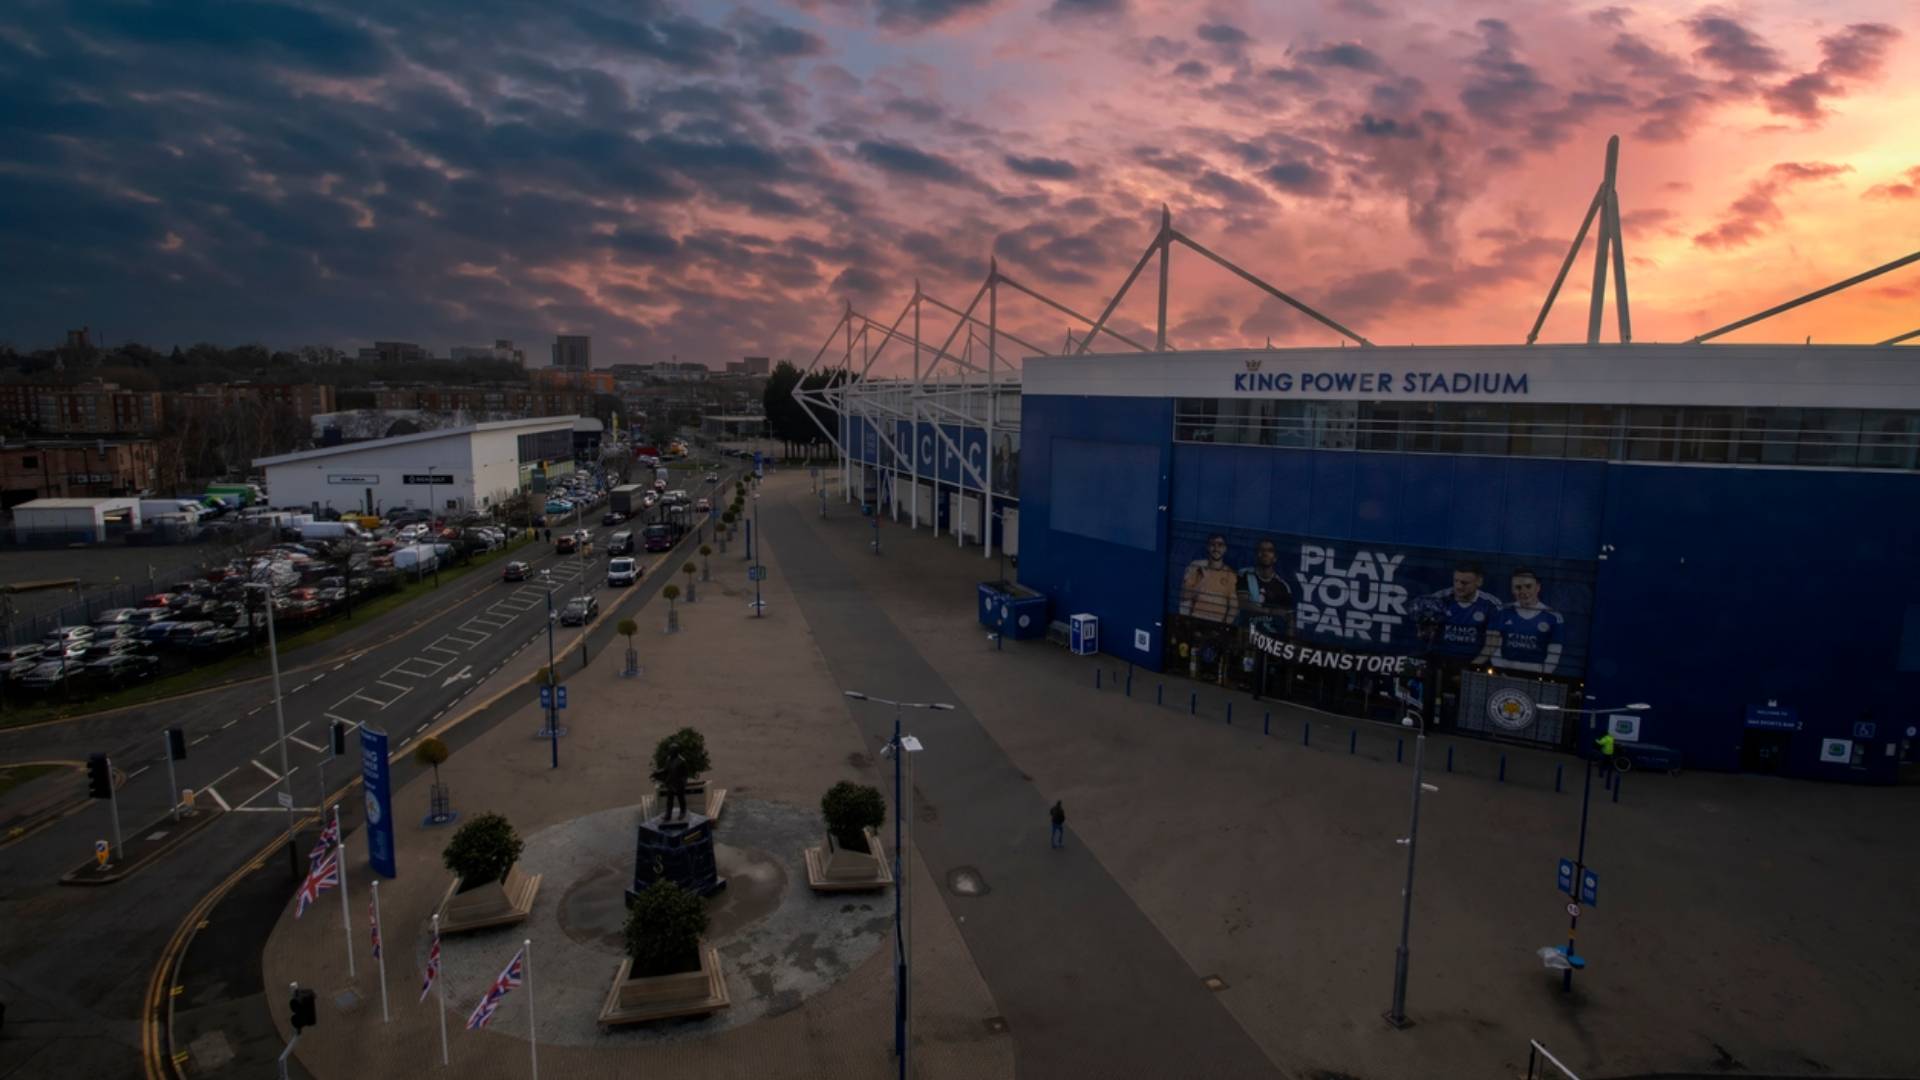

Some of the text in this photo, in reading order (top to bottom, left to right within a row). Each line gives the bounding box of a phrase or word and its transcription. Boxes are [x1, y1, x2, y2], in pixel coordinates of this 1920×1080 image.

[1234, 372, 1528, 394] KING POWER STADIUM
[1300, 544, 1405, 582] PLAY
[1295, 572, 1408, 616] YOUR
[1296, 602, 1403, 643] PART
[1252, 630, 1407, 674] FOXES FANSTORE
